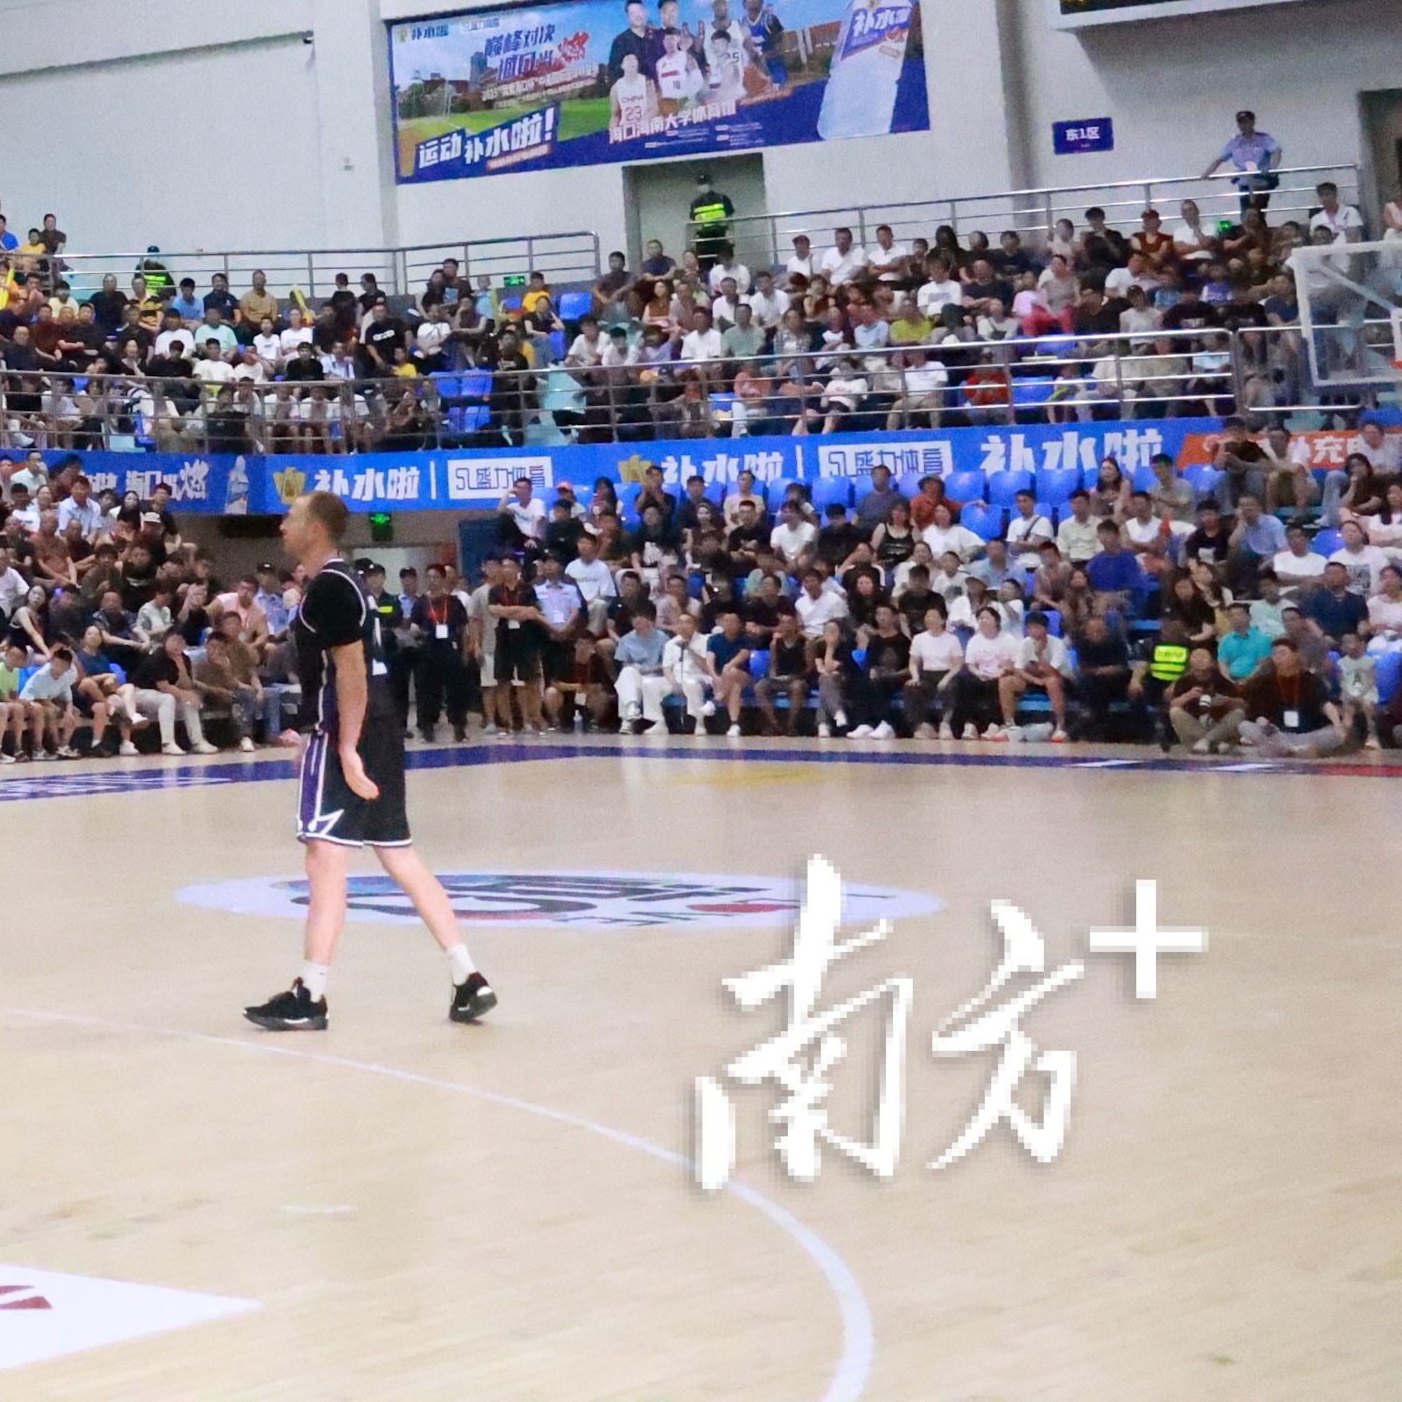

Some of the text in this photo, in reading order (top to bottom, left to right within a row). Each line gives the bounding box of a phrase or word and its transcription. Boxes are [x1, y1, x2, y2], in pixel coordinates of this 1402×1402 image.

[1065, 125, 1100, 141] 东1区
[980, 428, 1163, 478] 补水啦
